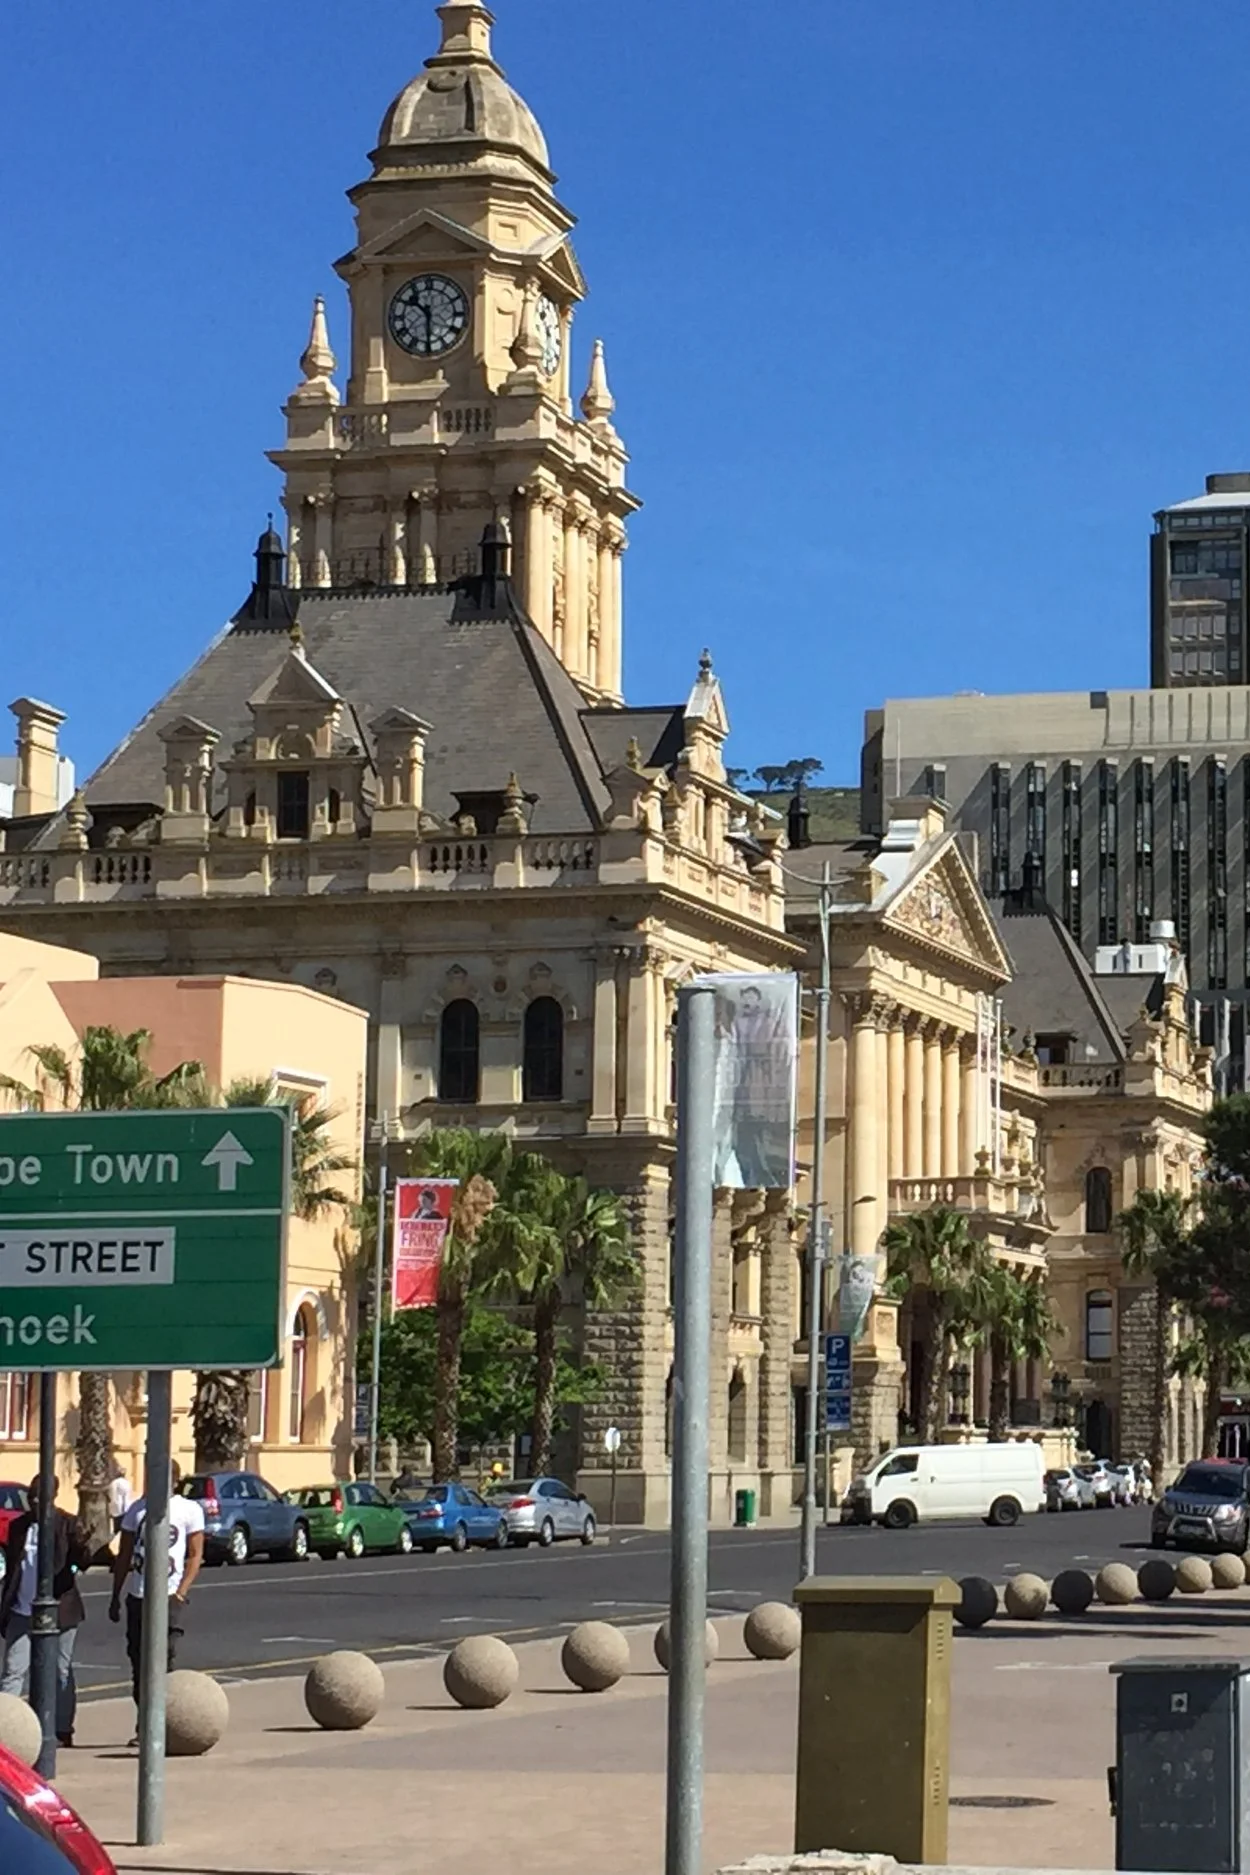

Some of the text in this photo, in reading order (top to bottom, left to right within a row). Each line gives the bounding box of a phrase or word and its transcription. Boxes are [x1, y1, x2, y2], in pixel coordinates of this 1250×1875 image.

[65, 1144, 179, 1184] Town
[26, 1241, 164, 1273] STREET
[832, 1339, 845, 1353] P
